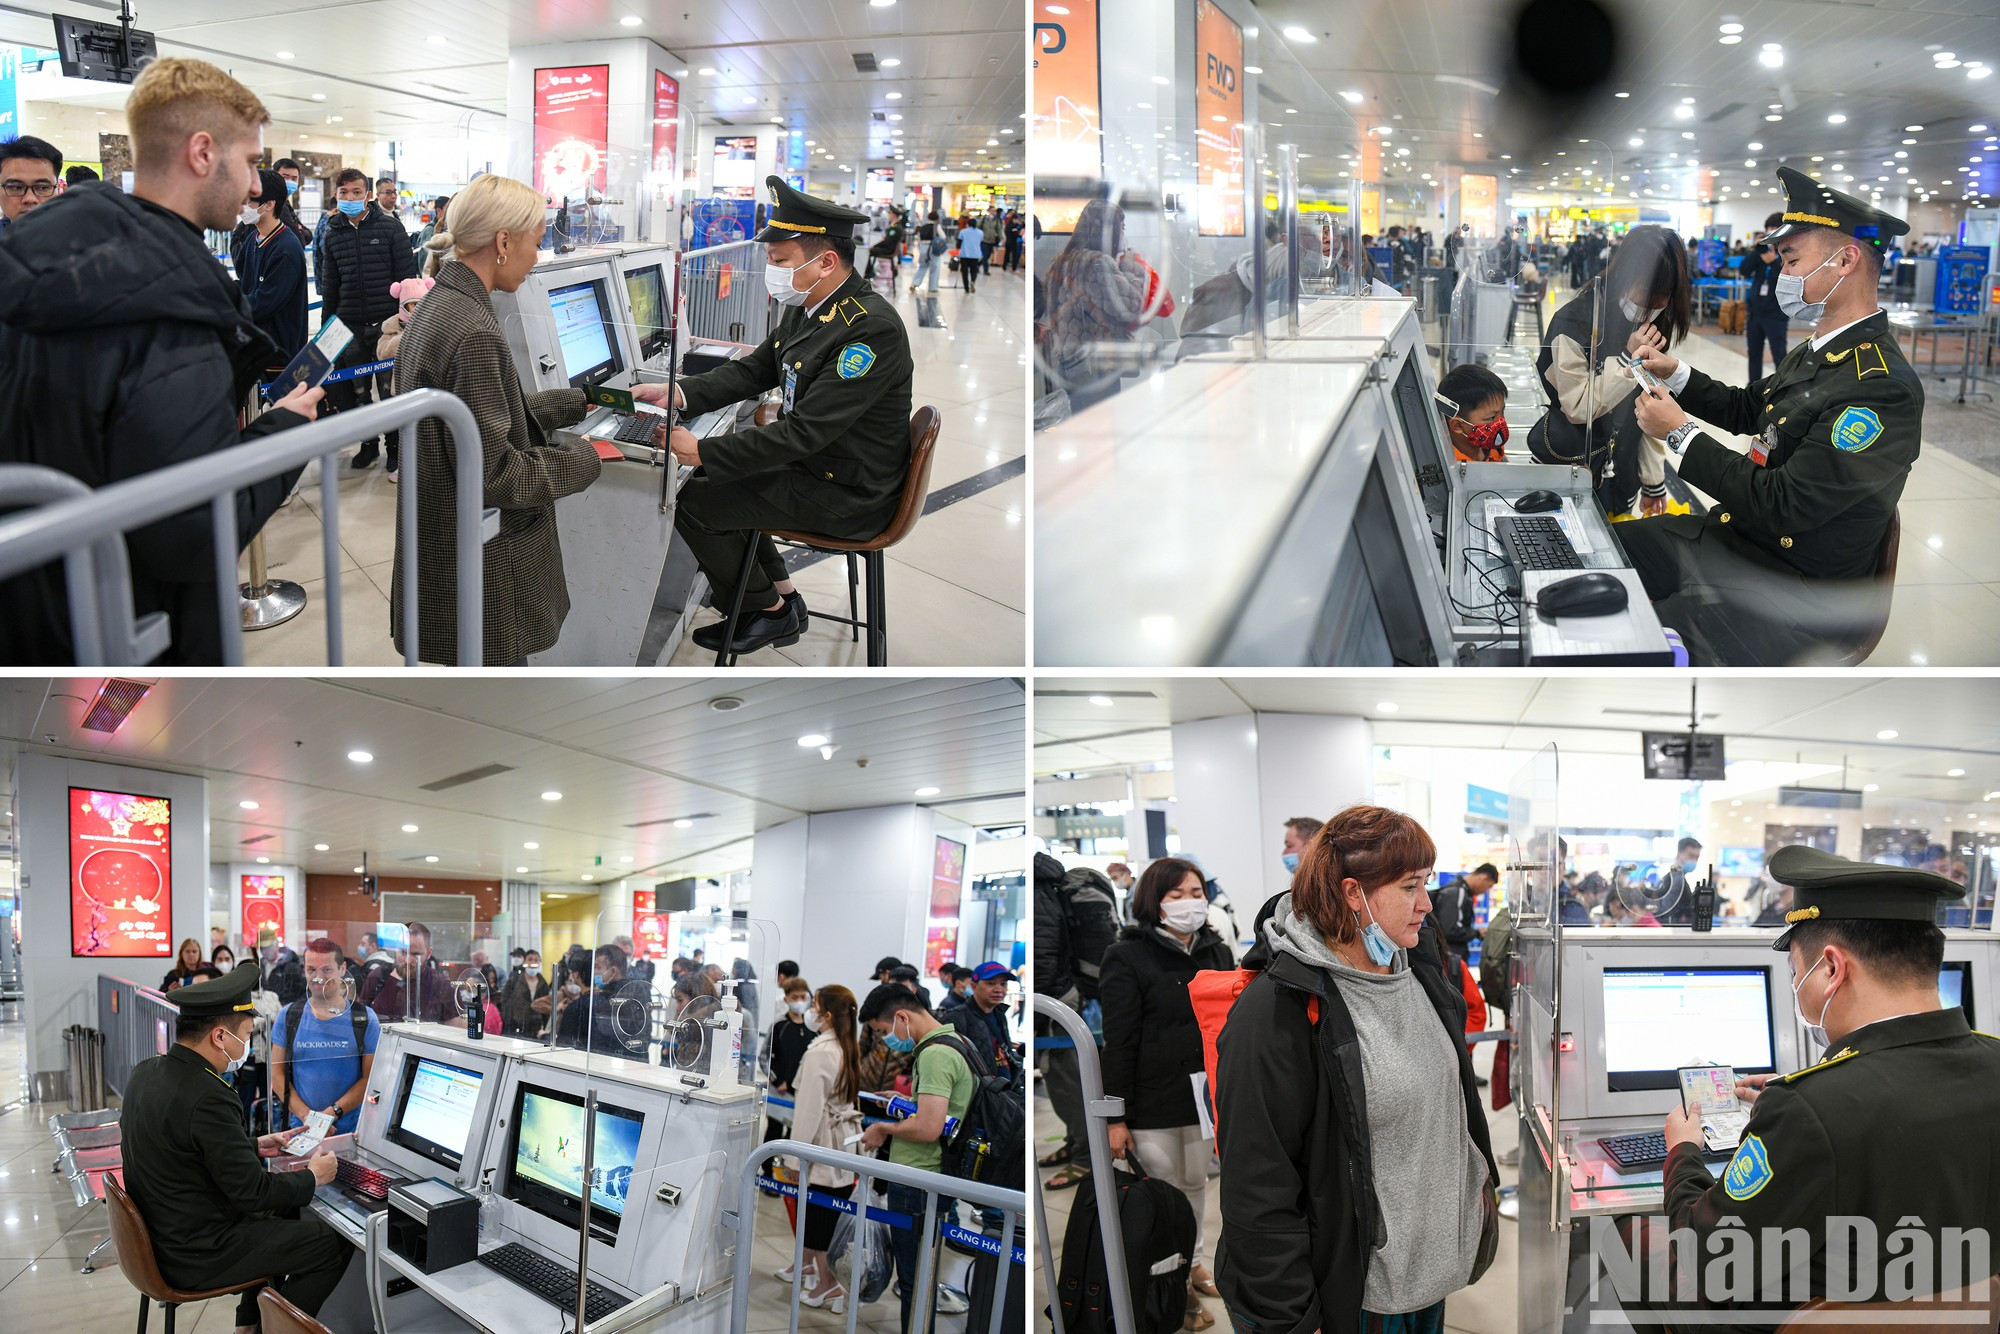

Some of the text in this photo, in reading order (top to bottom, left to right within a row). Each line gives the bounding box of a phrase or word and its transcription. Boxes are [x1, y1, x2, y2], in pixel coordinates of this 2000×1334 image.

[1207, 52, 1235, 93] FWD
[354, 361, 396, 376] NOIBAI INTERNA
[296, 1041, 341, 1049] BACKROADS
[781, 1186, 813, 1201] AIRPT
[832, 1199, 852, 1212] N.I.A
[949, 1228, 980, 1247] CẢNG
